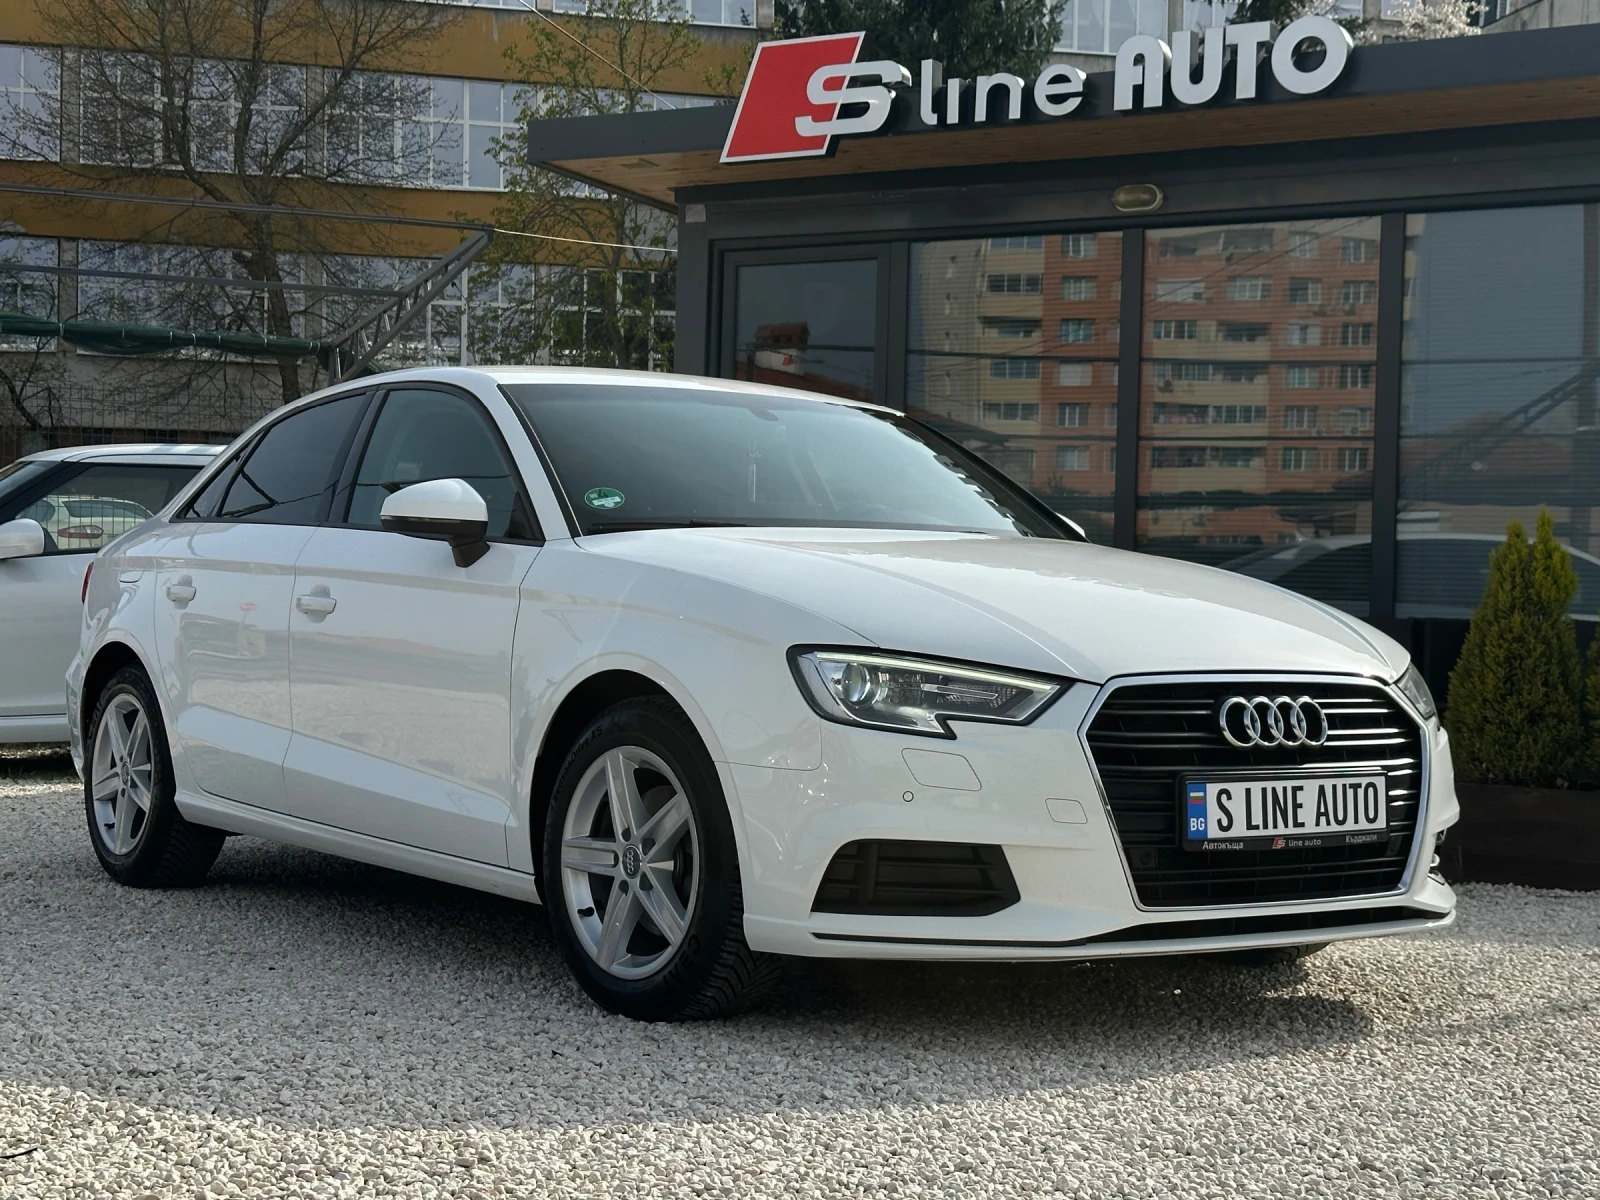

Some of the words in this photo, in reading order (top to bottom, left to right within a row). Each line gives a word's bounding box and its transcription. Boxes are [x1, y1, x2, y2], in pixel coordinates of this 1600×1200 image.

[794, 59, 908, 138] S
[920, 59, 1086, 125] line
[1113, 15, 1350, 111] AUTO
[1215, 787, 1234, 833] S
[1244, 785, 1306, 831] LINE
[1314, 781, 1379, 828] AUTO
[1189, 818, 1205, 831] BG
[1202, 840, 1244, 850] Автокъща
[1288, 838, 1303, 847] line
[1304, 838, 1322, 846] auto
